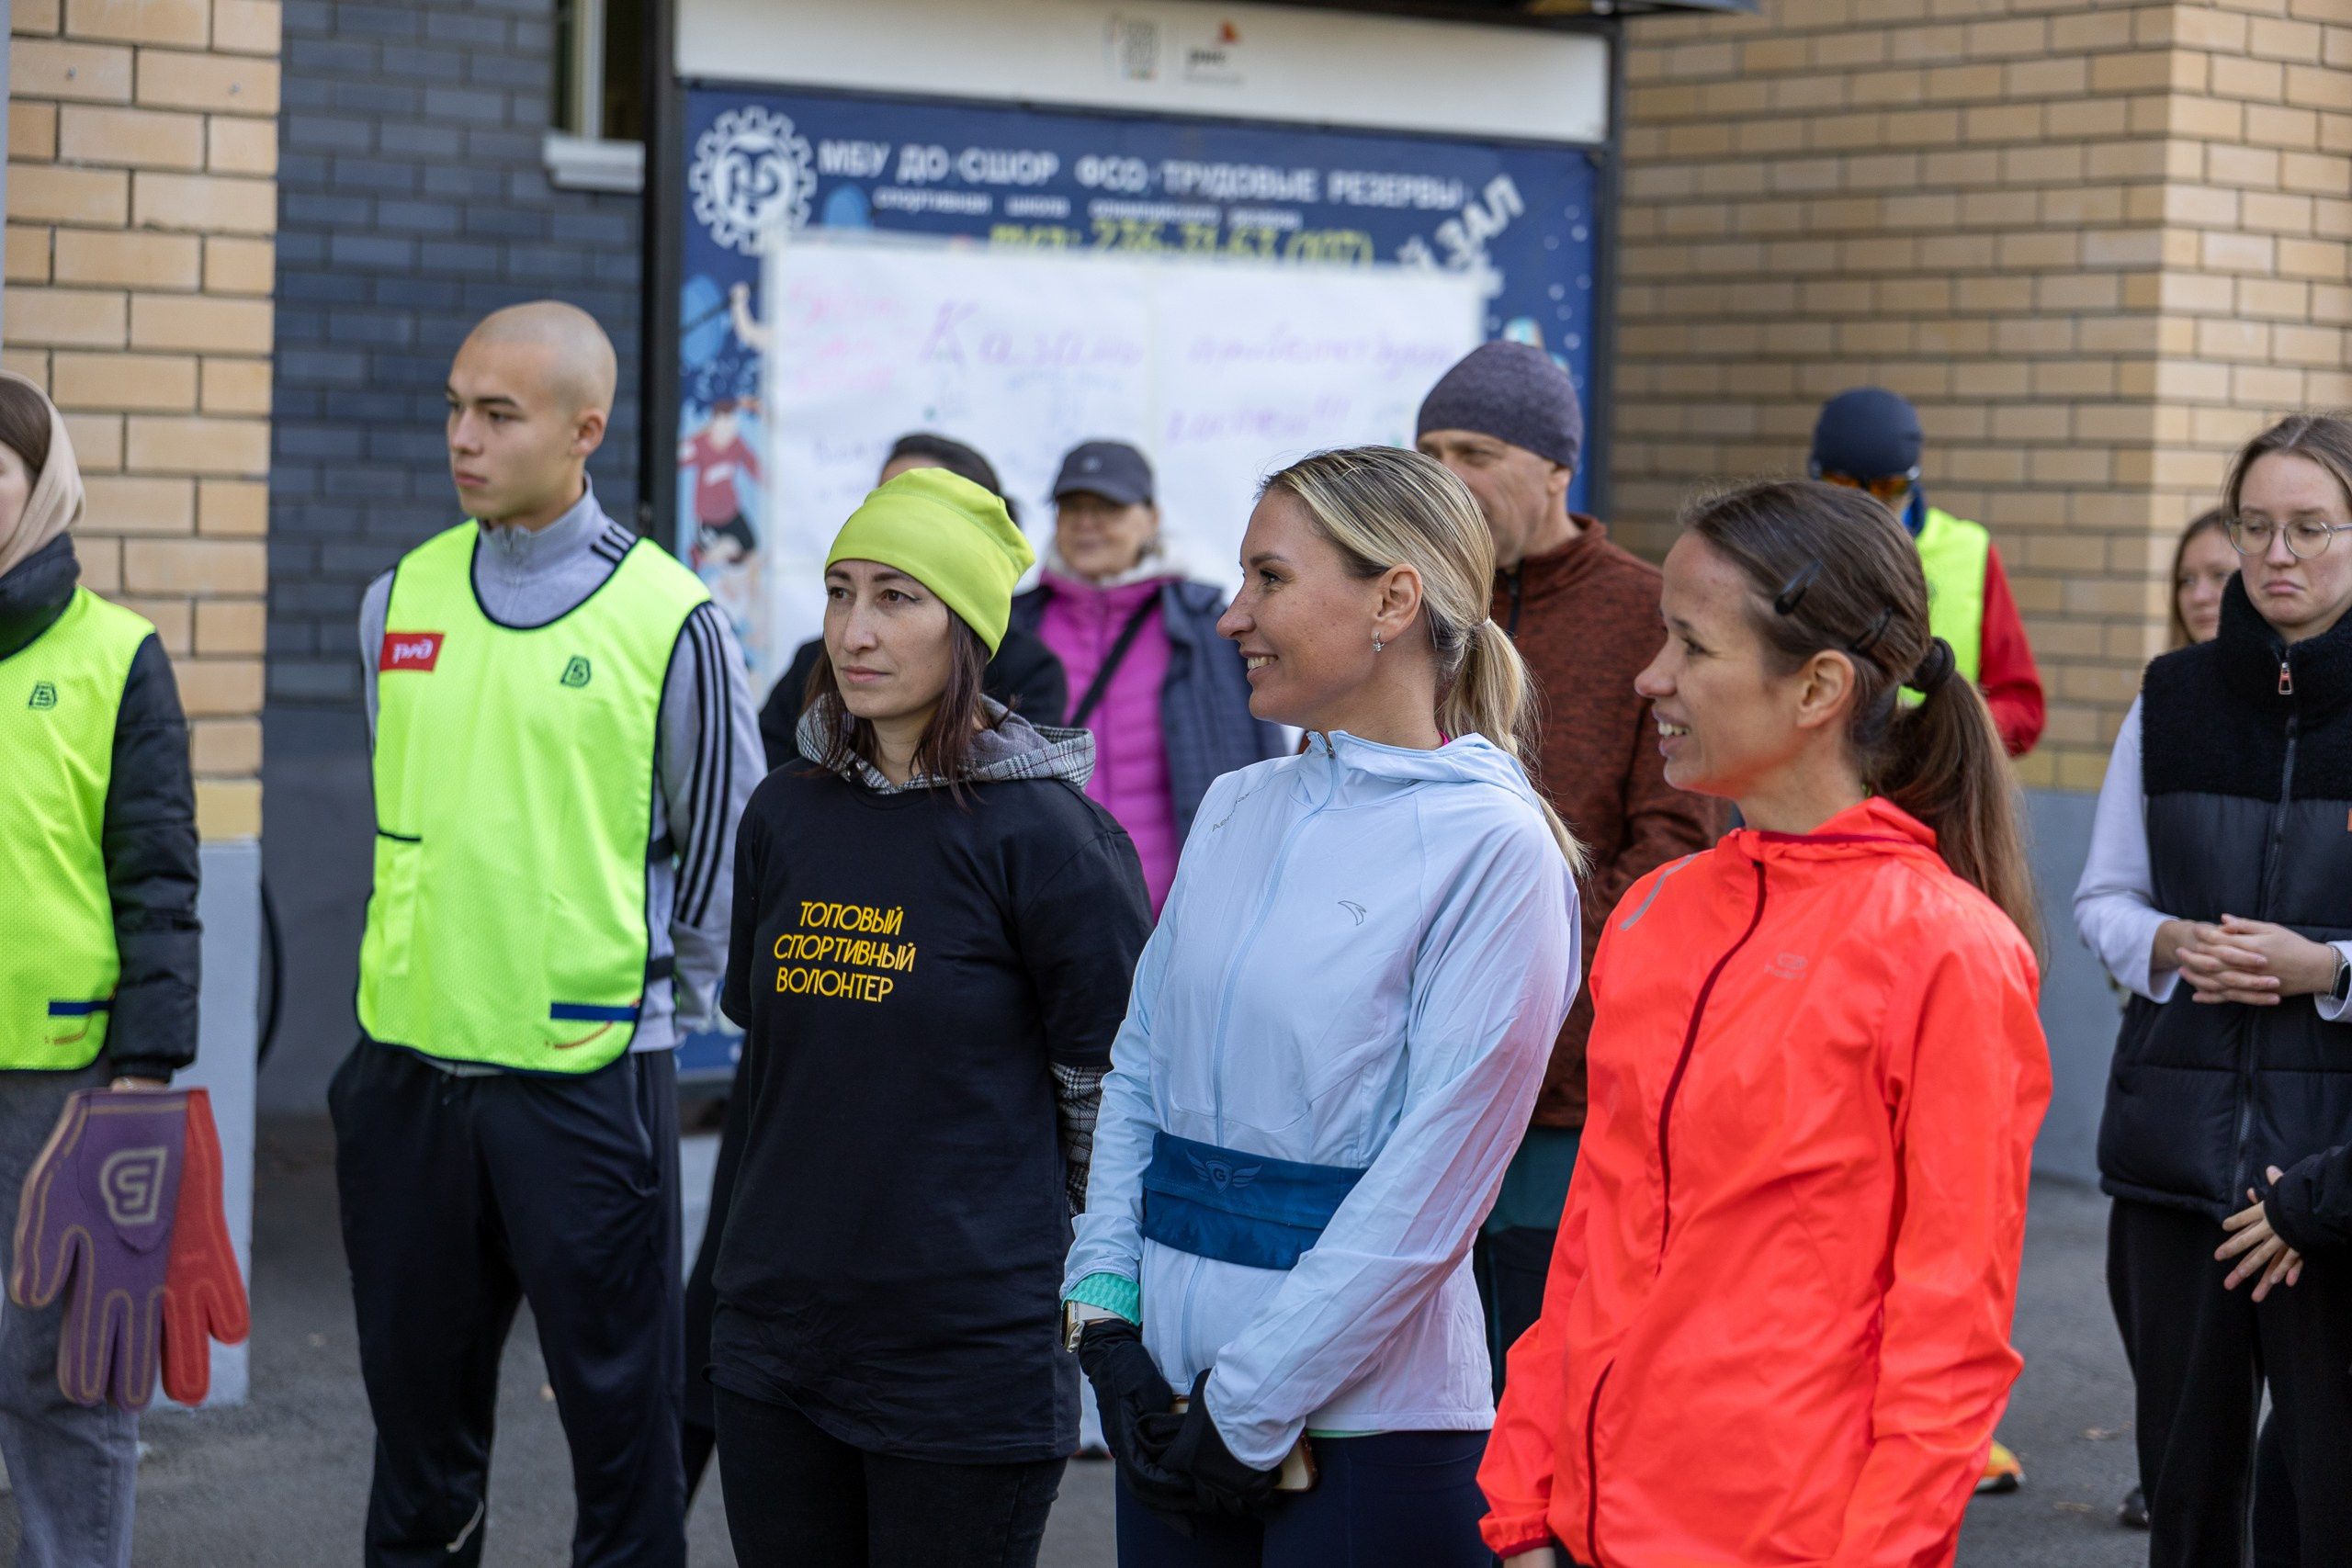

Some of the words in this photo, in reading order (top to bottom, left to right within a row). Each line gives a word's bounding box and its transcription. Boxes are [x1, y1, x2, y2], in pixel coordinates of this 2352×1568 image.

[818, 139, 890, 178] МБУ
[896, 142, 950, 186] ДО
[800, 901, 904, 936] ТОПОВЫЙ
[774, 933, 917, 973] СПОРТИВНЫЙ
[776, 966, 894, 1002] ВОЛОНТЕР
